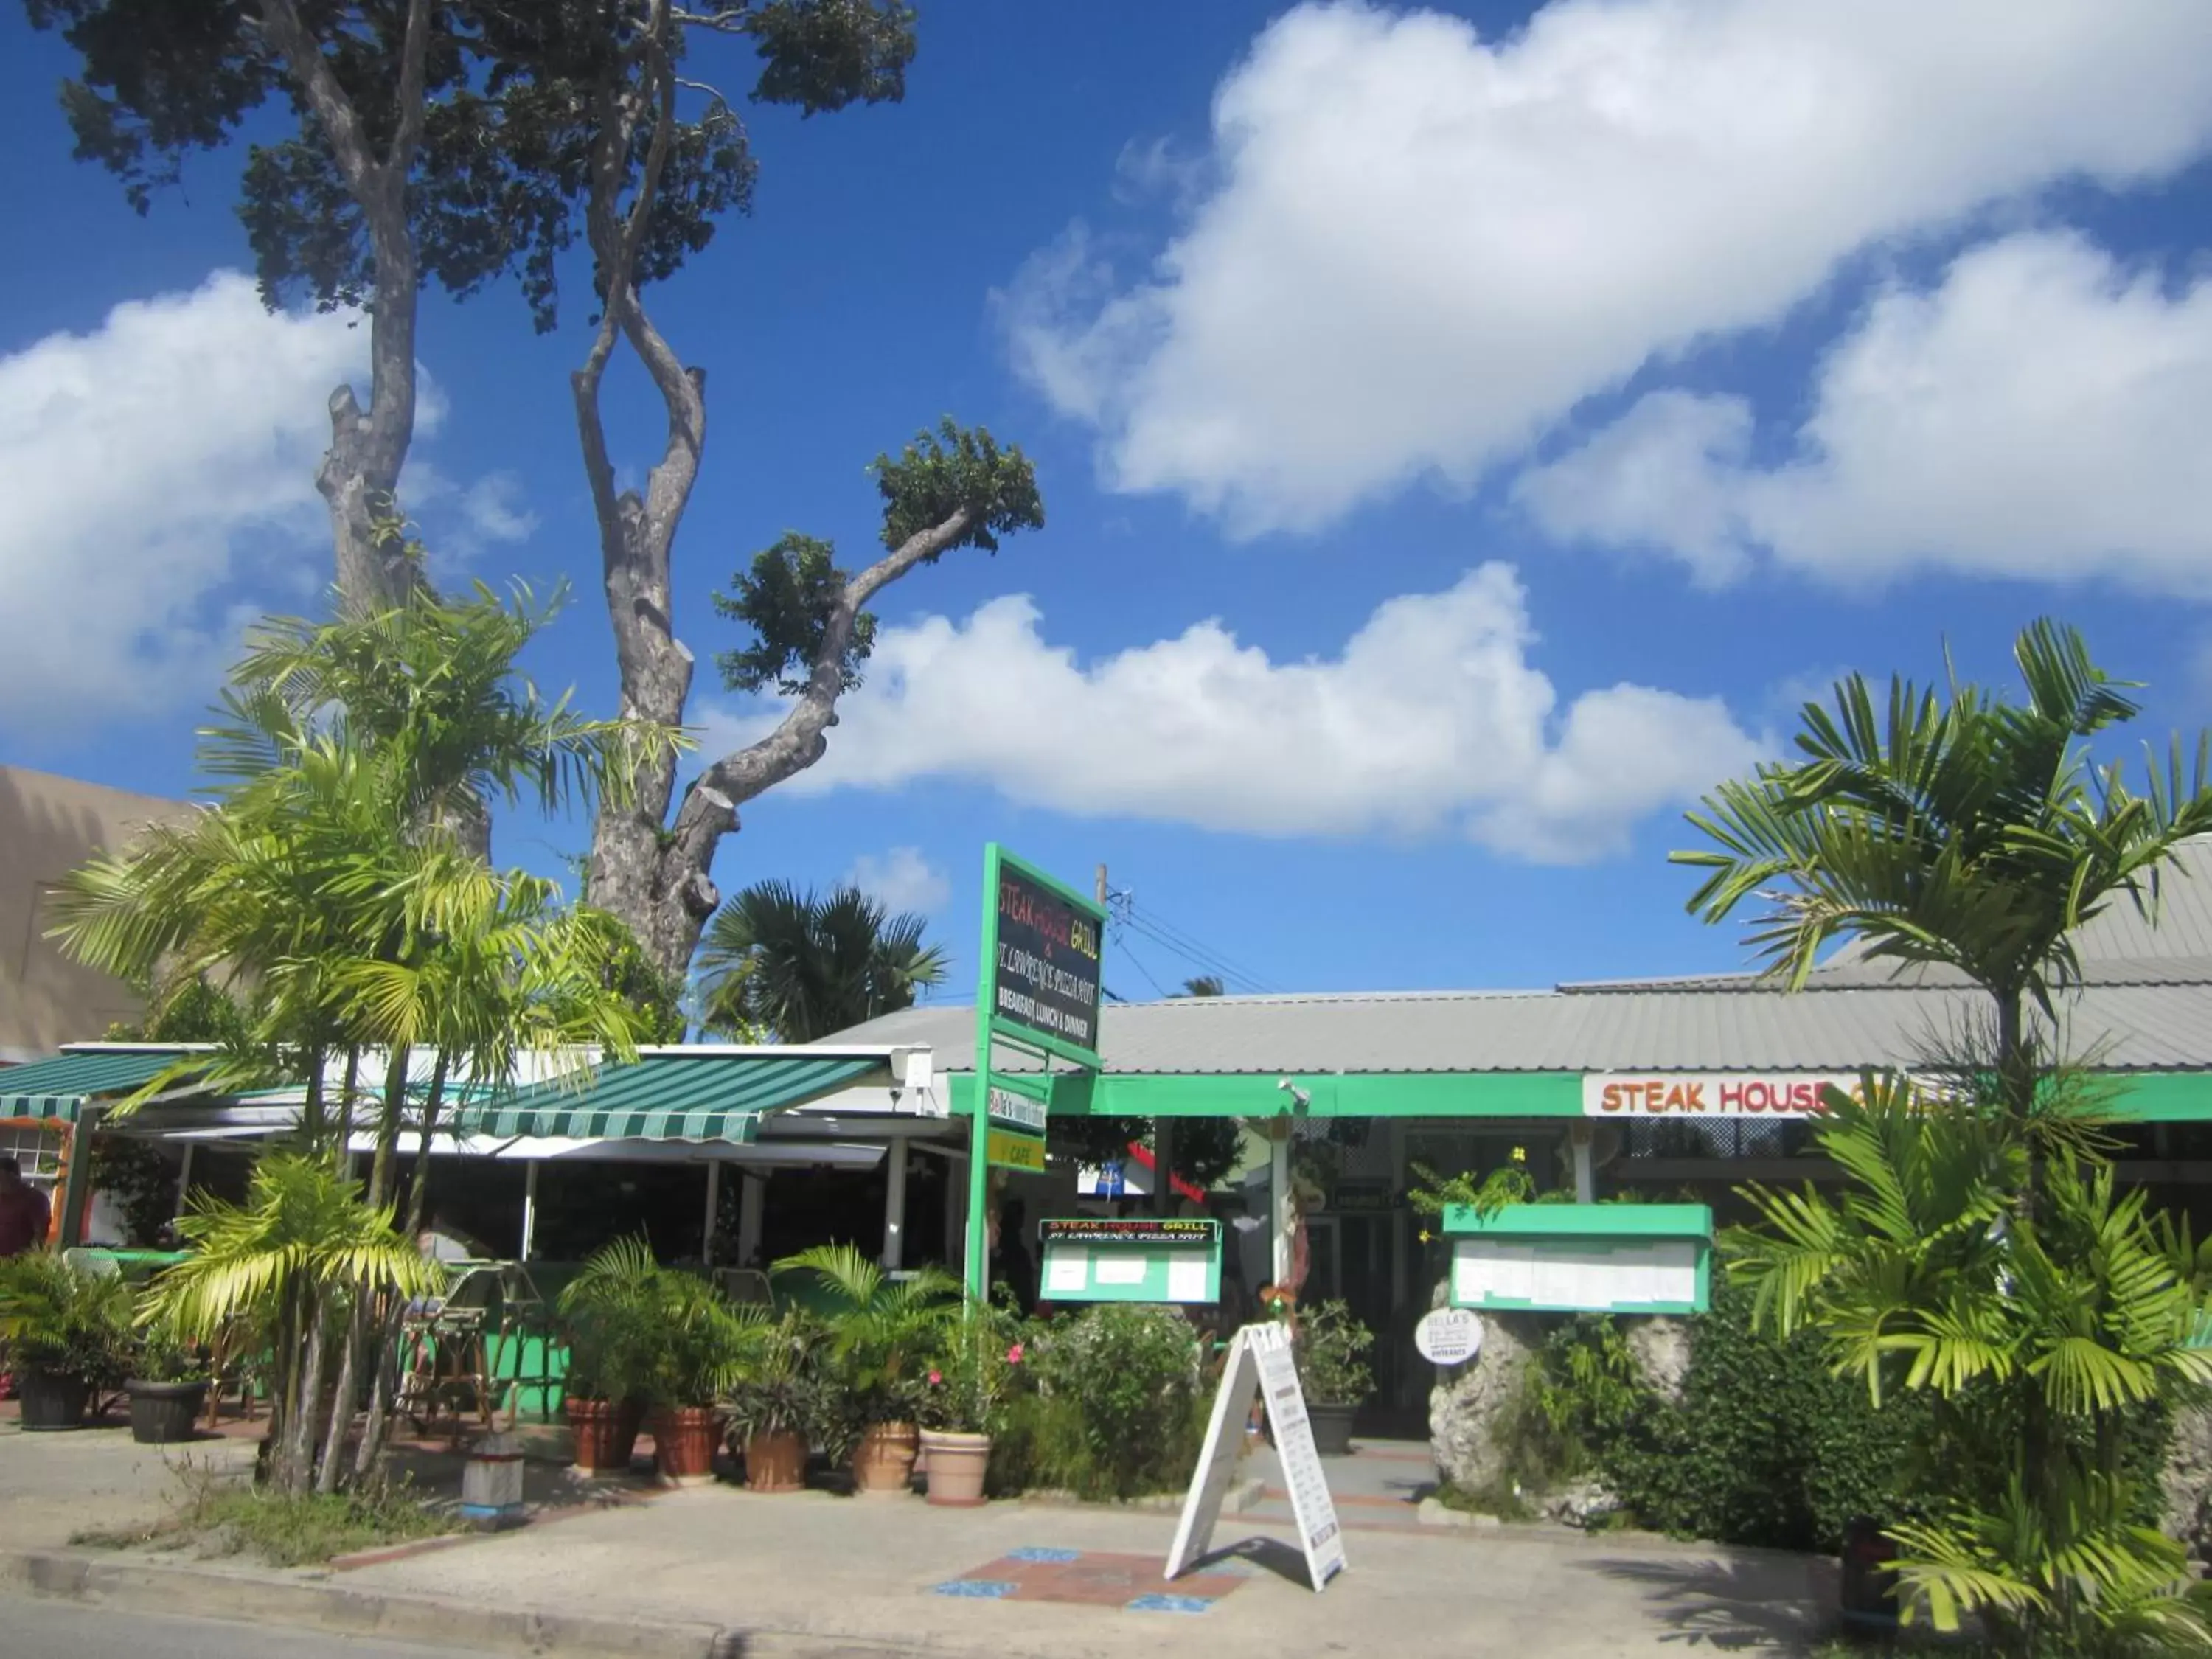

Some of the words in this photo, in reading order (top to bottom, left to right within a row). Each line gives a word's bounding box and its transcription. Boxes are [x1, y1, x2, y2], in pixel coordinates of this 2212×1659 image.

[1071, 919, 1097, 959] GRILL
[1035, 1002, 1059, 1029] LUNCH
[1064, 1014, 1088, 1039] DINNER
[1601, 1082, 1706, 1113] STEAK
[1049, 1221, 1100, 1230] STEAK
[1104, 1221, 1158, 1231] HOUSE
[1162, 1222, 1208, 1231] GRILL
[1138, 1232, 1175, 1240] PIZZA
